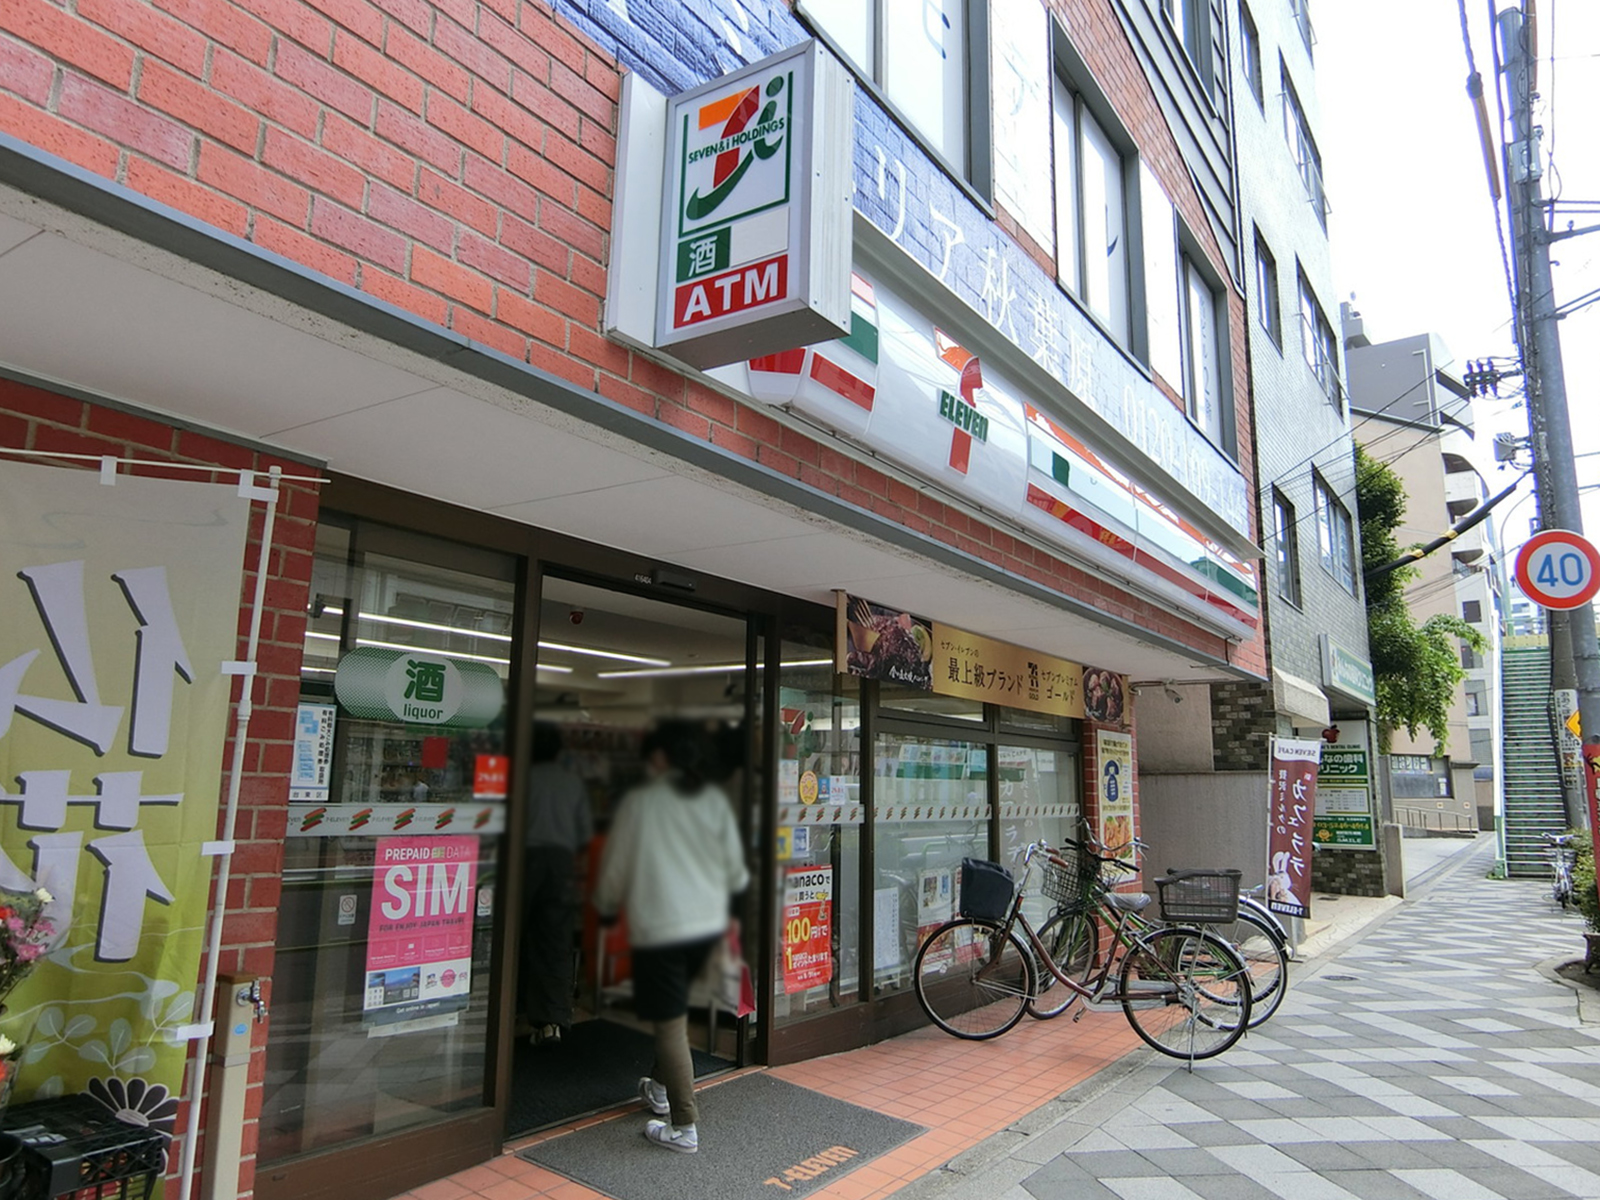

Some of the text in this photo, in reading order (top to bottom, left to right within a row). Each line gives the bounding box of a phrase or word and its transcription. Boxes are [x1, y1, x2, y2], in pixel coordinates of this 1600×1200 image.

[732, 116, 785, 150] HOLDINGS
[688, 235, 717, 277] 酒
[682, 260, 779, 323] ATM
[870, 144, 1097, 409] リア秋葉原
[939, 389, 989, 444] ELEVEN
[1537, 553, 1584, 587] 40
[404, 659, 446, 702] 酒
[948, 656, 1024, 695] 最上級ブランド
[1047, 685, 1075, 705] ゴールド
[403, 704, 443, 720] liquor
[1318, 764, 1358, 774] リニック
[1320, 753, 1364, 763] なの歯科
[385, 847, 430, 861] PREPAID
[381, 863, 470, 919] SIM
[763, 1145, 859, 1190] 7-ELEVEN
